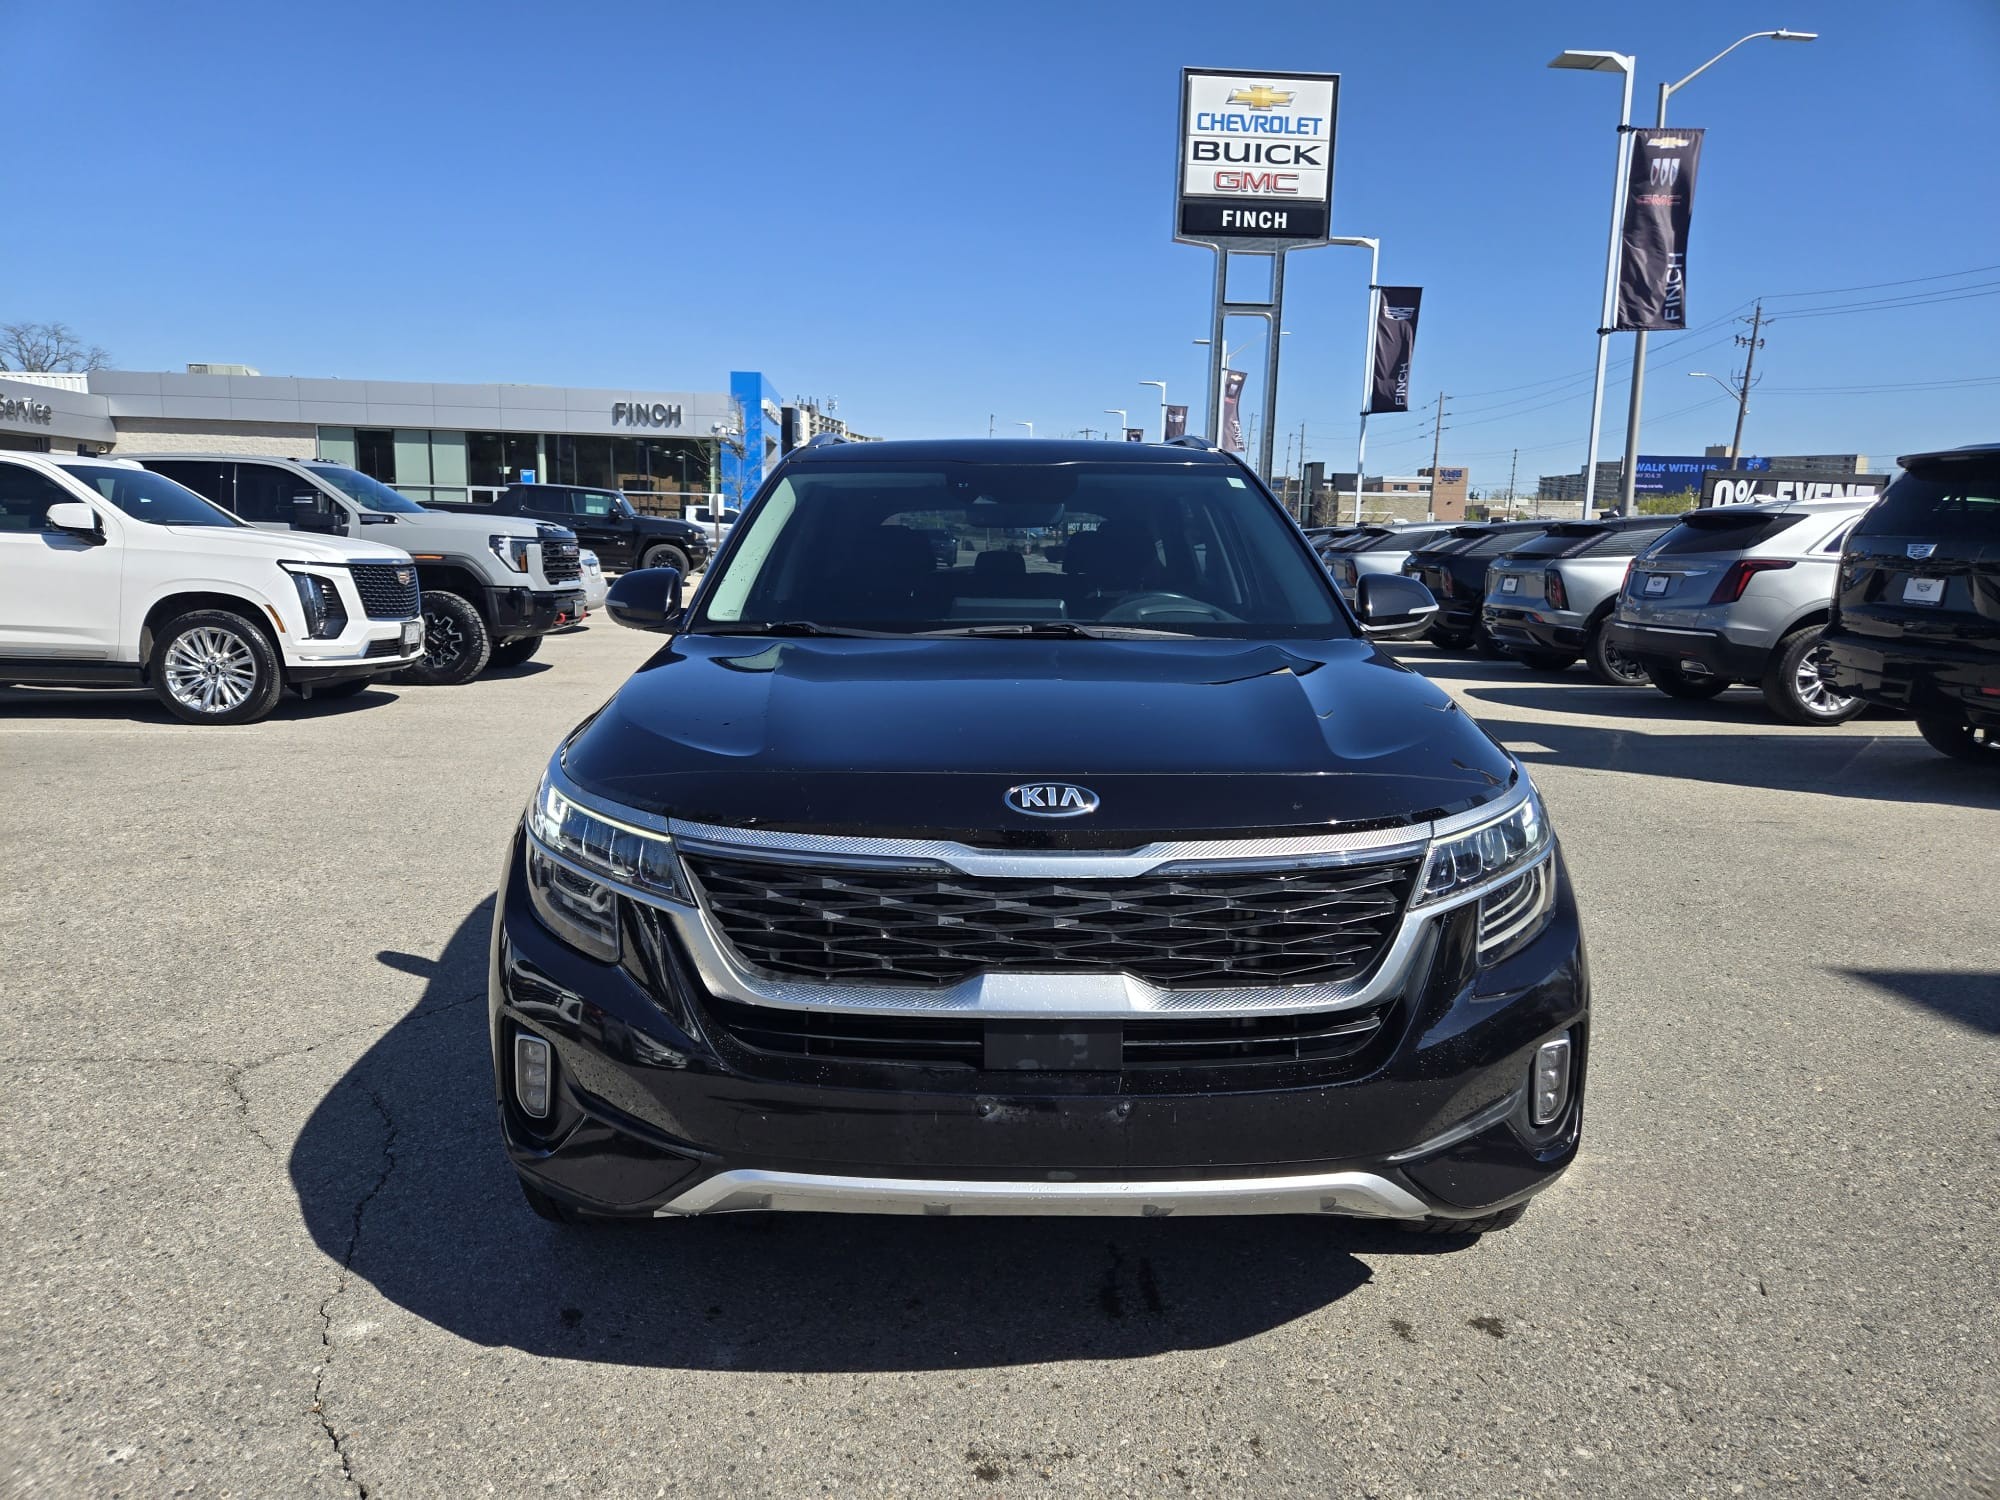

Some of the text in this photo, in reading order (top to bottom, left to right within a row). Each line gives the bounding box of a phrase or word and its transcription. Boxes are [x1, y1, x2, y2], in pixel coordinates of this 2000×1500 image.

[1197, 112, 1323, 135] CHEVROLET
[1192, 141, 1322, 165] BUICK
[1214, 171, 1299, 194] GMC
[1222, 210, 1288, 229] FINCH
[1664, 252, 1683, 321] FINCH
[1395, 362, 1408, 406] FINCH
[613, 402, 682, 426] FINCH
[1636, 463, 1666, 472] WALK
[1669, 464, 1698, 473] WITH
[1712, 480, 1757, 507] 0%
[1021, 787, 1085, 808] KIA
